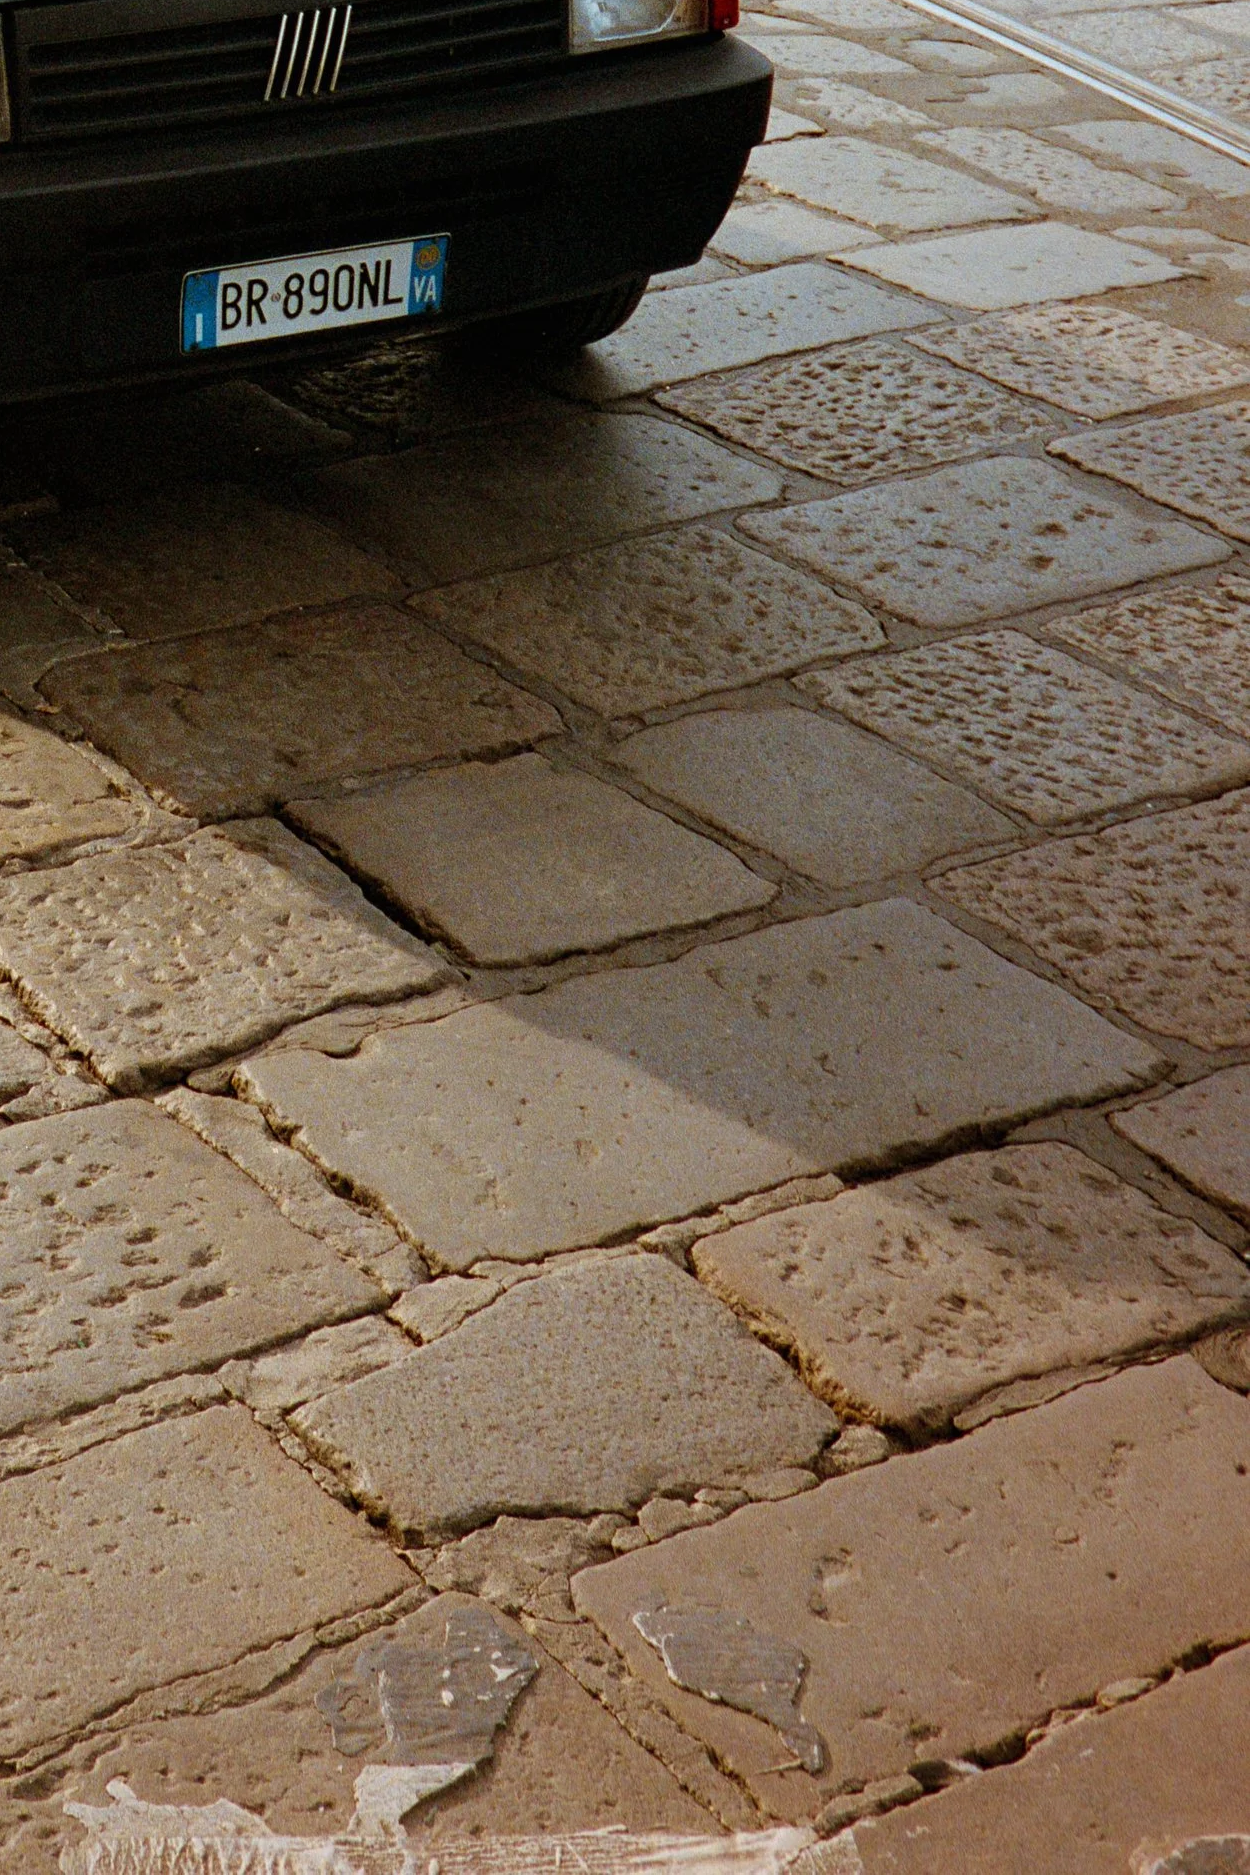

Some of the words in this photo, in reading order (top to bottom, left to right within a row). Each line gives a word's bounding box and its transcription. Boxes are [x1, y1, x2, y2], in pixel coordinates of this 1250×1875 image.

[221, 278, 268, 331] BR
[282, 258, 404, 320] 890NL
[413, 274, 438, 303] VA
